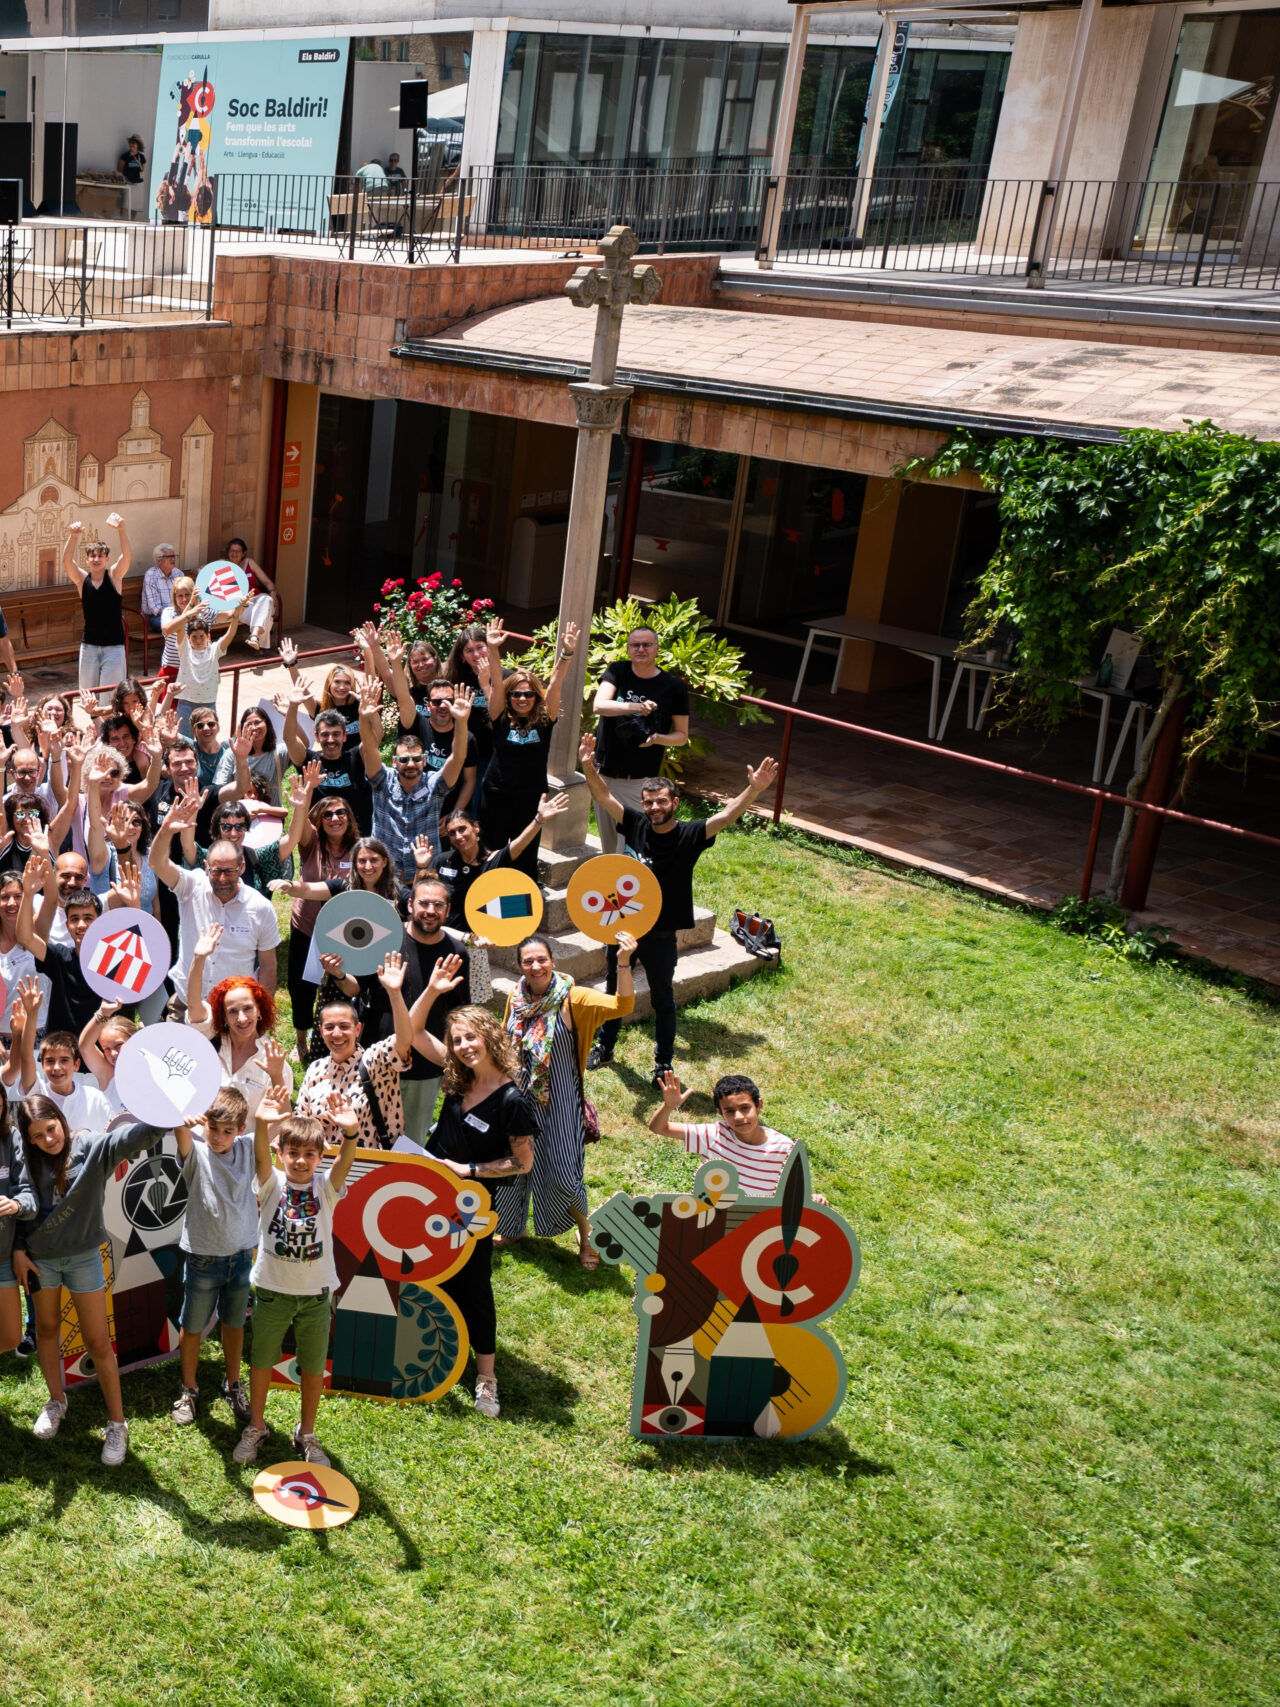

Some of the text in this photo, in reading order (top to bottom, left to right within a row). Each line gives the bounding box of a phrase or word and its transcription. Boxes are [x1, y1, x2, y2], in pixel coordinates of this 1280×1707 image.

[302, 51, 336, 61] Els Baldiri
[228, 97, 329, 118] Soc Baldiri!
[226, 122, 296, 135] Fem que les arts
[224, 136, 275, 147] transformin
